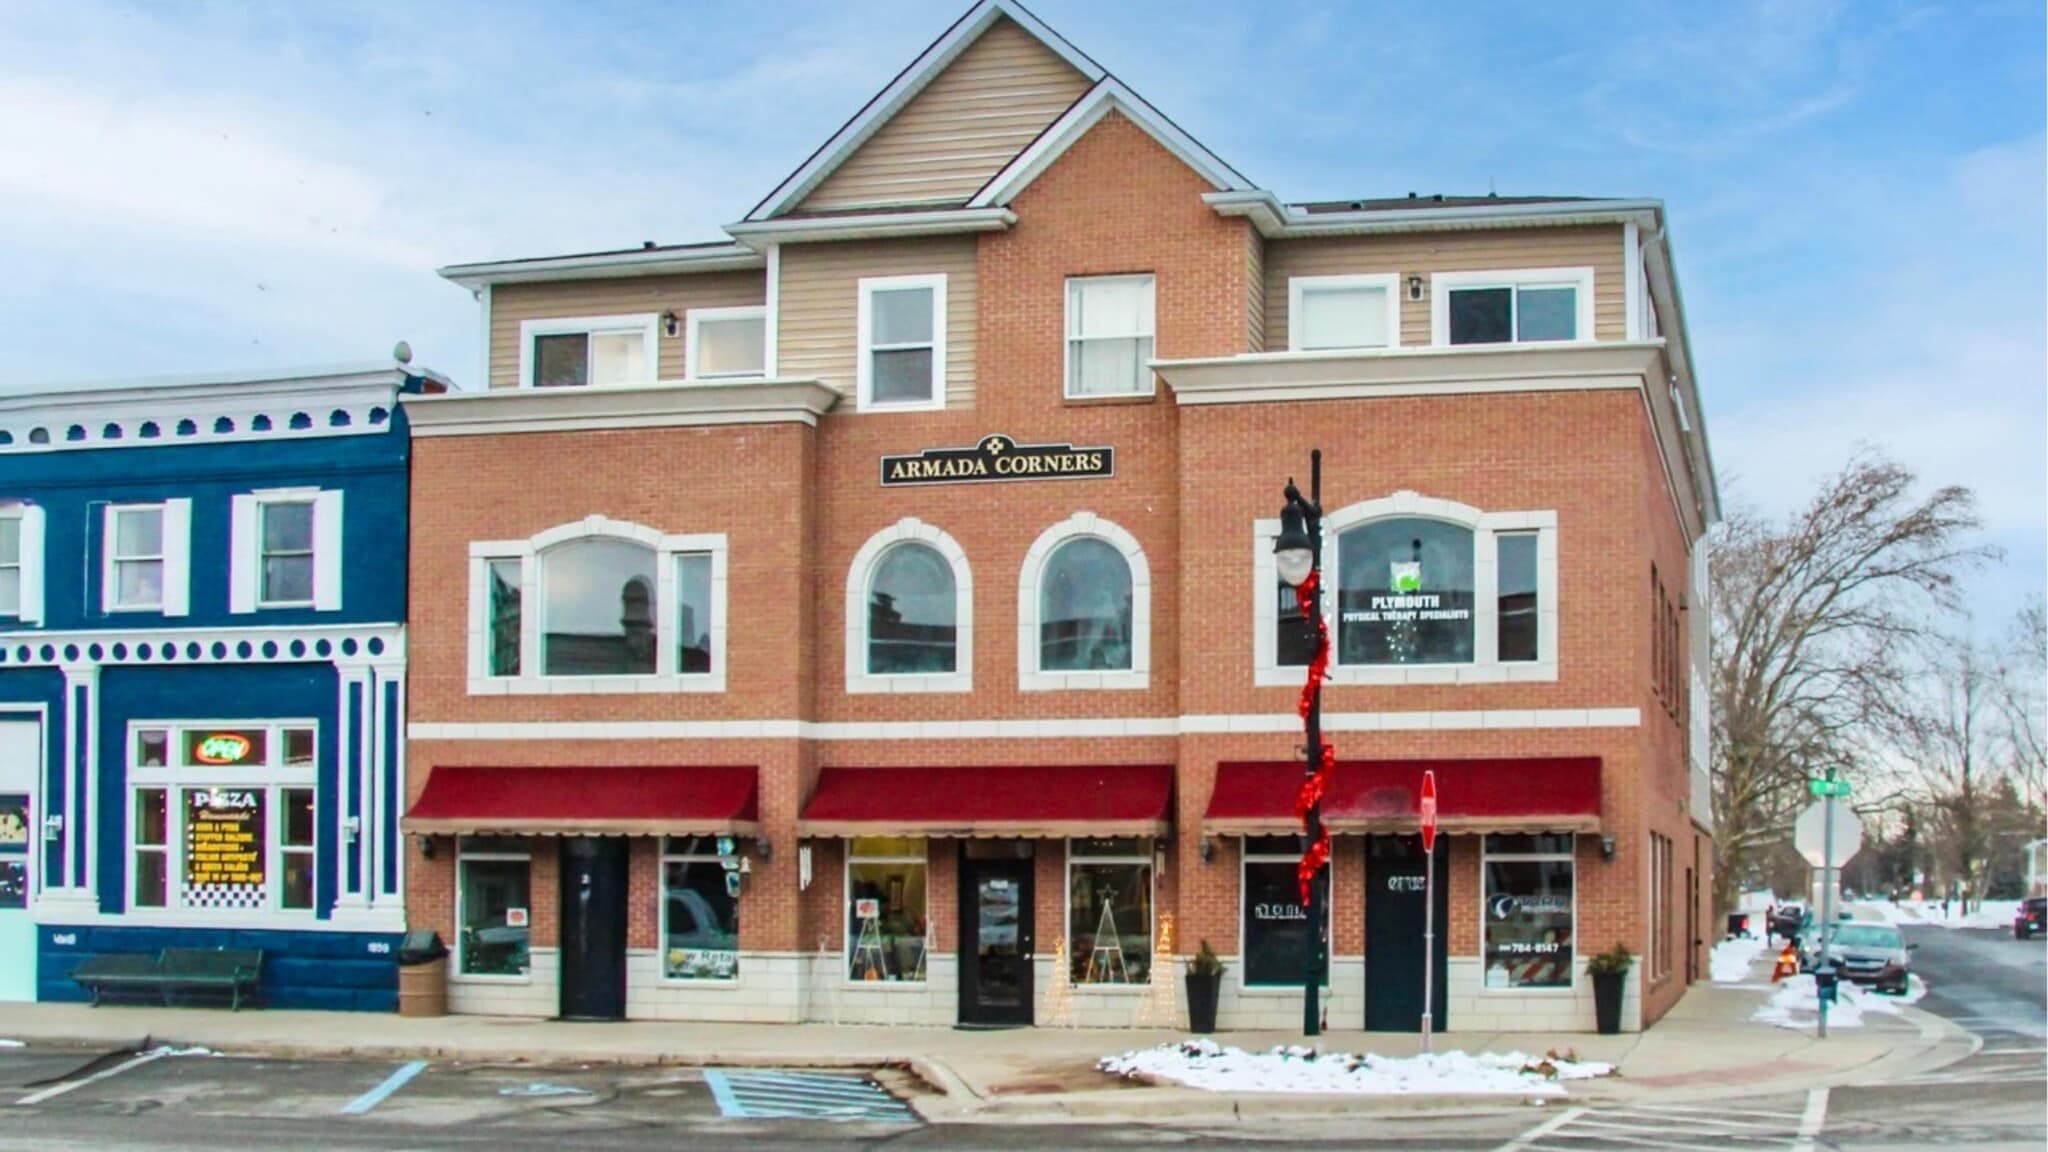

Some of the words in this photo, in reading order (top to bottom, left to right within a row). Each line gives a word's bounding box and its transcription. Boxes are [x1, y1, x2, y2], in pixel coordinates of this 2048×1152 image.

[891, 457, 988, 479] ARMADA
[995, 453, 1103, 474] CORNERS
[1371, 594, 1440, 609] PLYMOUTH
[1343, 612, 1380, 622] PHYSICAL
[1382, 610, 1418, 621] THERAPY
[1420, 609, 1469, 620] SPECIALISTS
[202, 738, 243, 760] OPEN
